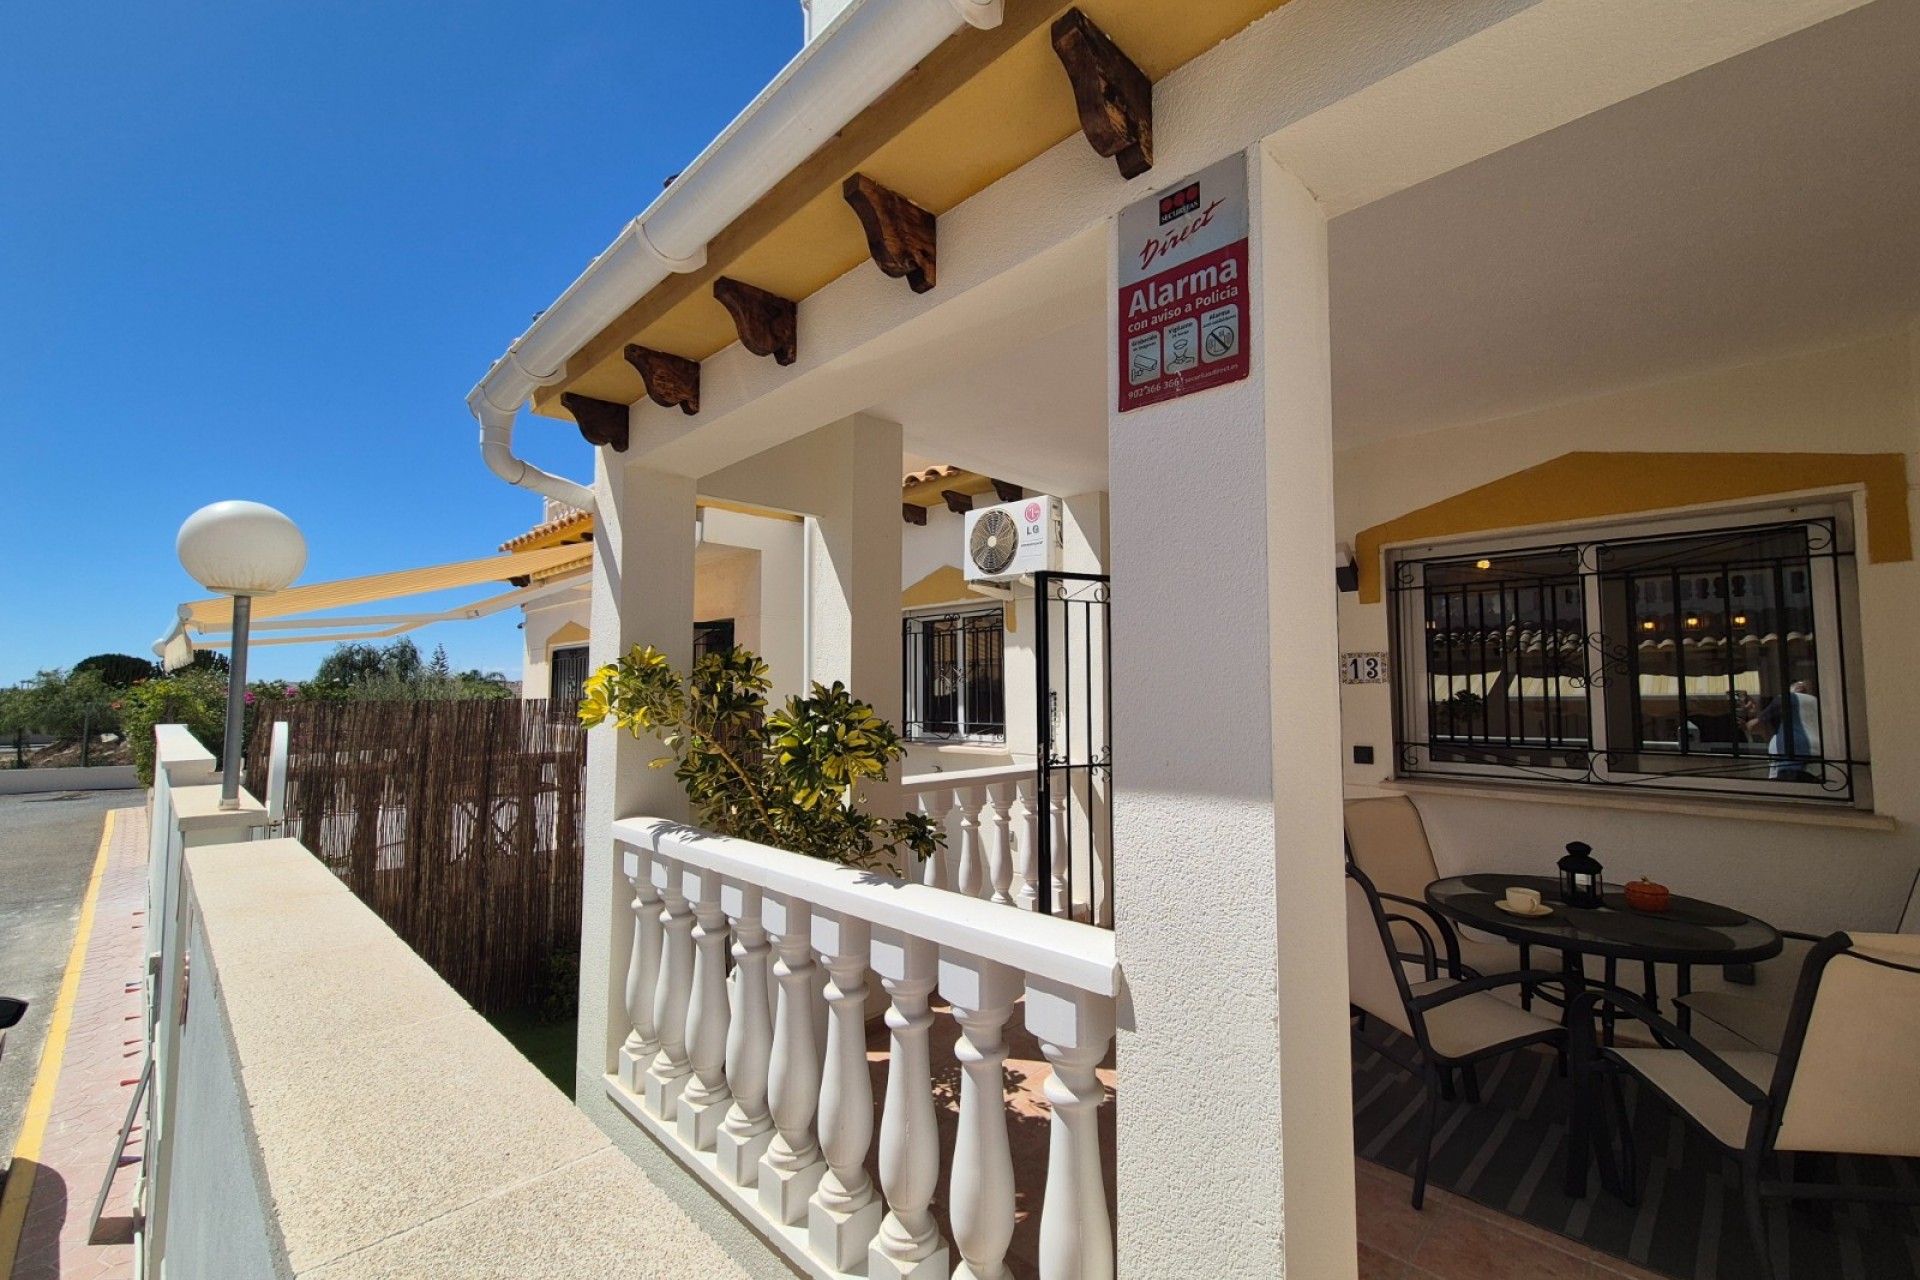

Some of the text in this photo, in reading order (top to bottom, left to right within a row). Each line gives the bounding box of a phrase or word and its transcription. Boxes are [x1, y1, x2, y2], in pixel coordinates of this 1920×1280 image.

[1139, 196, 1226, 270] Direct
[1128, 258, 1238, 318] Alarma
[1128, 284, 1239, 333] con aviso a Policía
[1026, 525, 1039, 536] LG
[1350, 658, 1378, 679] 13
